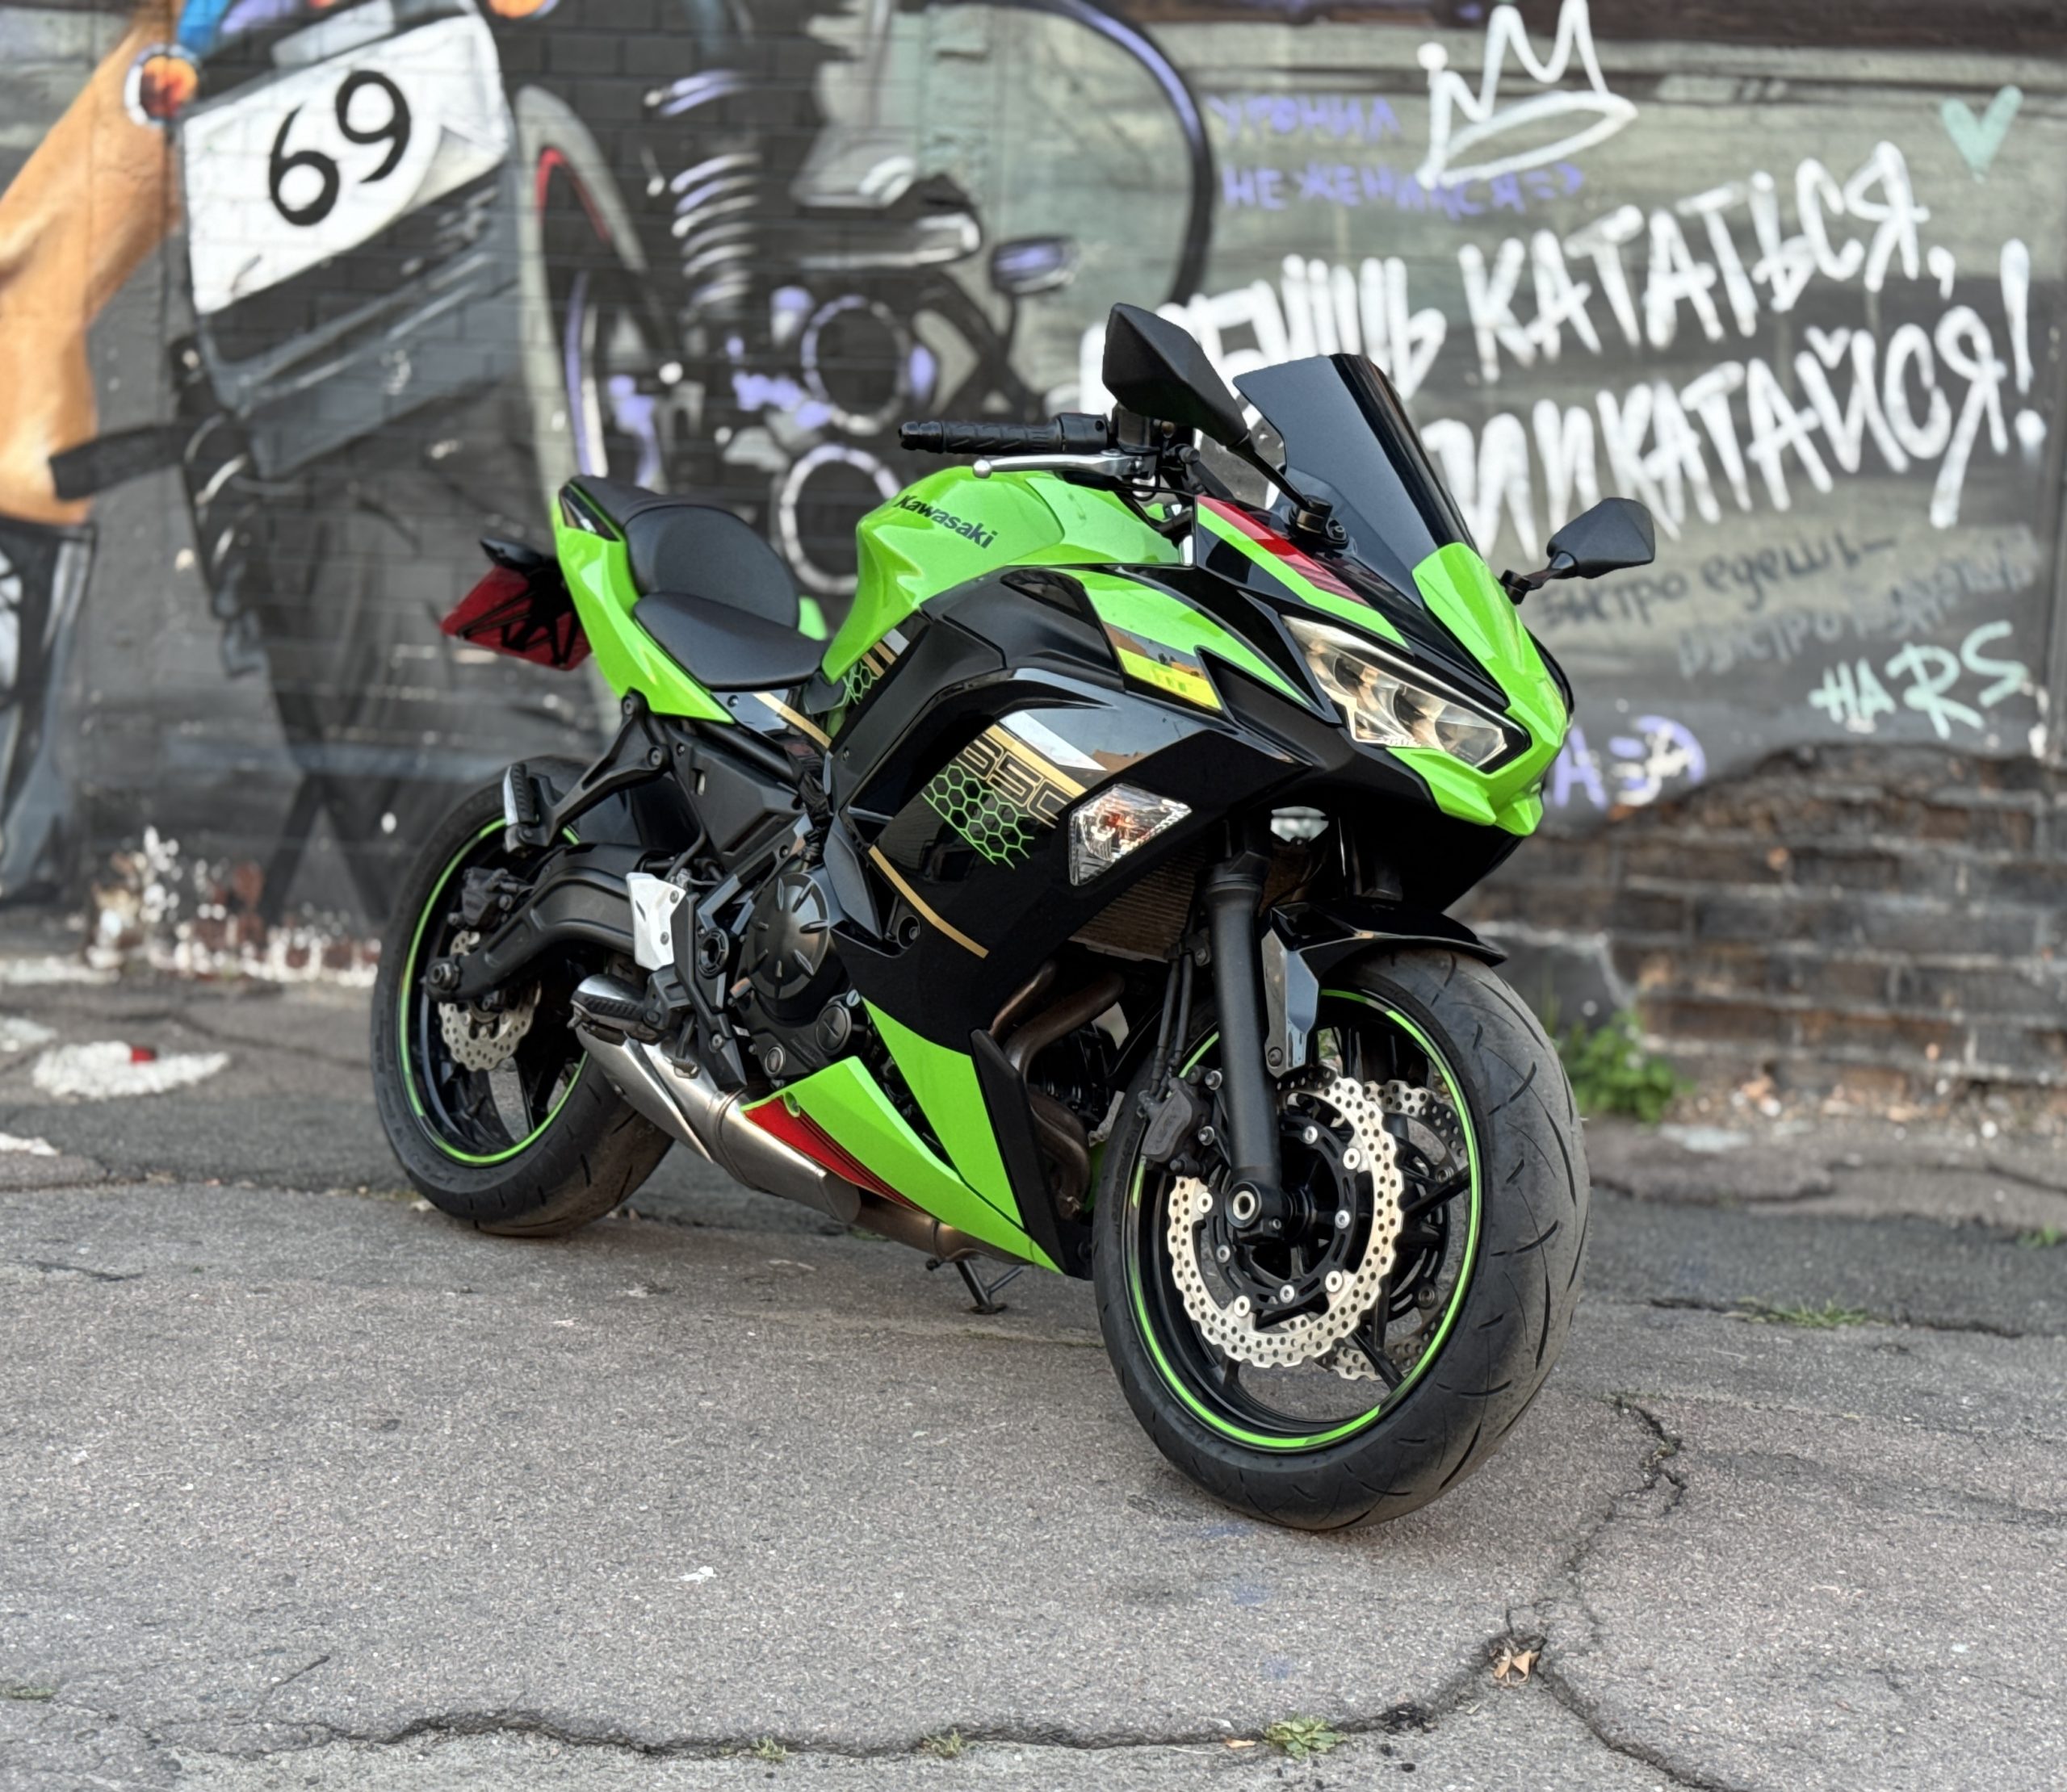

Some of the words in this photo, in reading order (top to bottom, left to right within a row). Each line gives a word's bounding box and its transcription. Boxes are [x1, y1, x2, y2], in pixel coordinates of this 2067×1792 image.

[268, 69, 412, 227] 69
[1221, 164, 1289, 211] НЕ
[893, 494, 999, 550] Kawasaki
